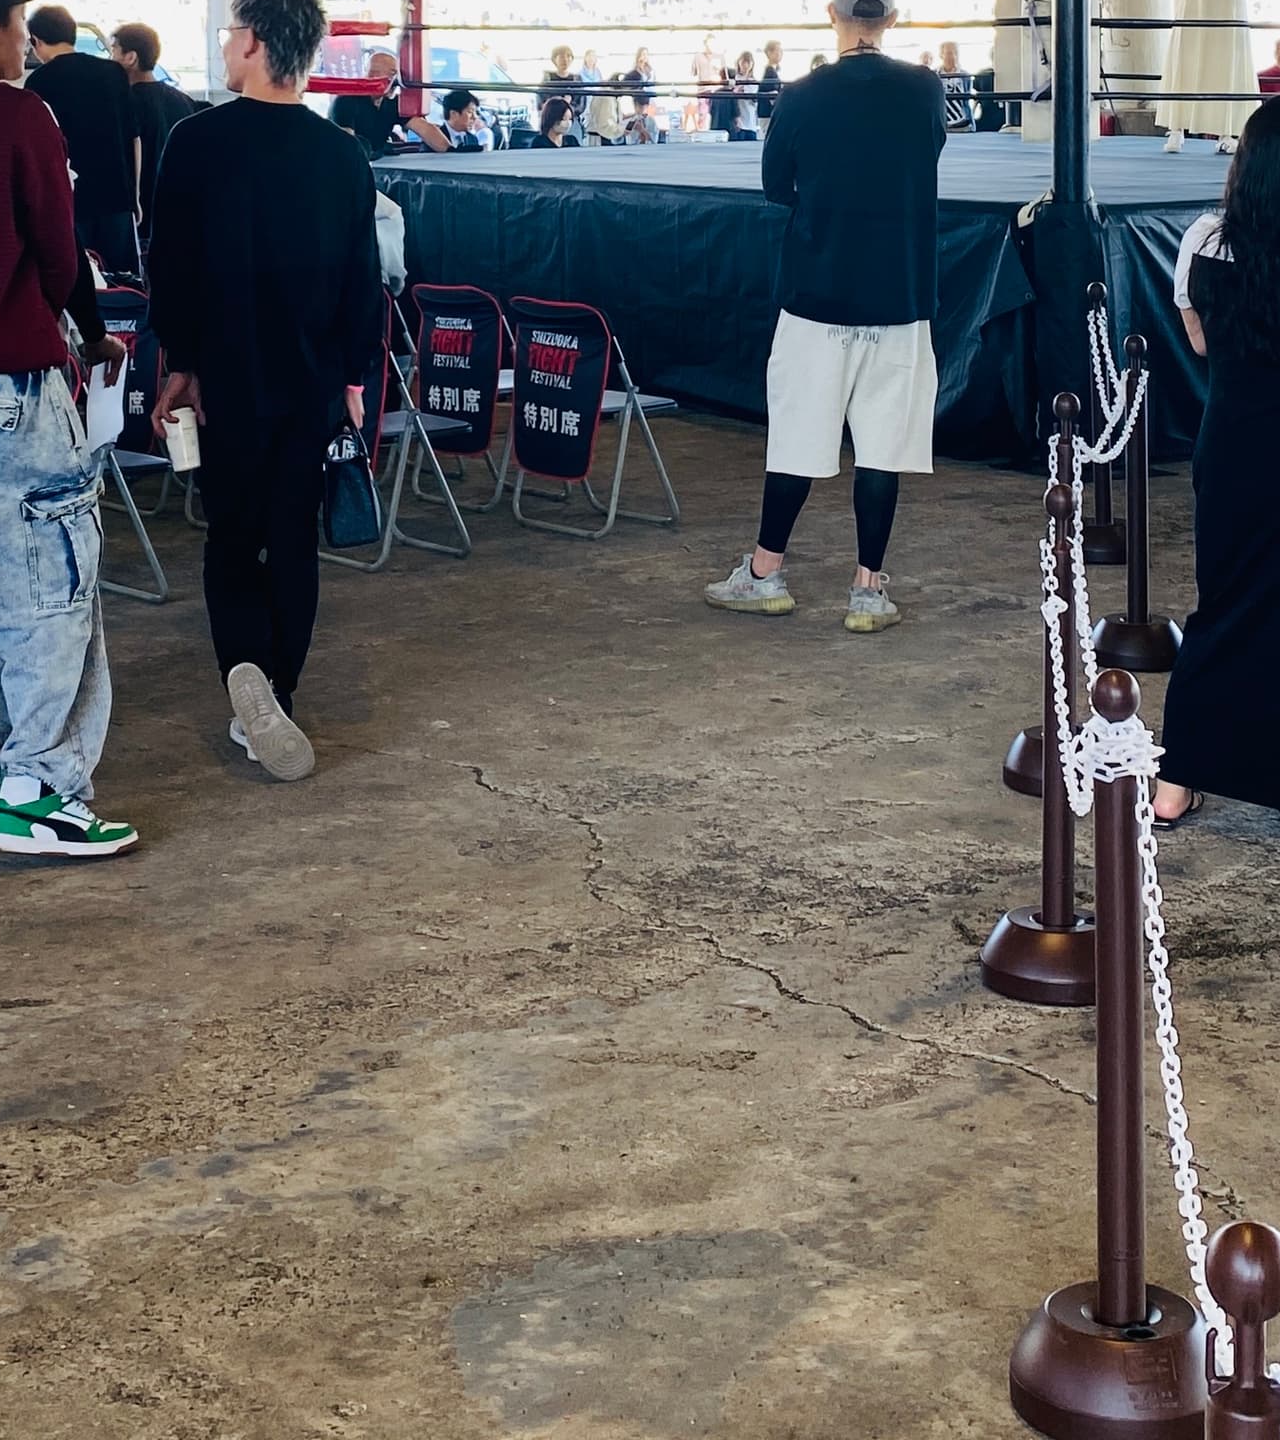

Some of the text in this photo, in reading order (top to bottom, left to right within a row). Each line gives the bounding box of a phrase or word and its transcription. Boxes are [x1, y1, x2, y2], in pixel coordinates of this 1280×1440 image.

[531, 330, 579, 350] SHIZUOKA
[432, 354, 471, 369] FESTIVAL
[528, 343, 582, 376] FIGHT
[530, 370, 573, 390] FESTIVAL
[428, 384, 481, 413] 特別席
[522, 401, 581, 437] 特別席
